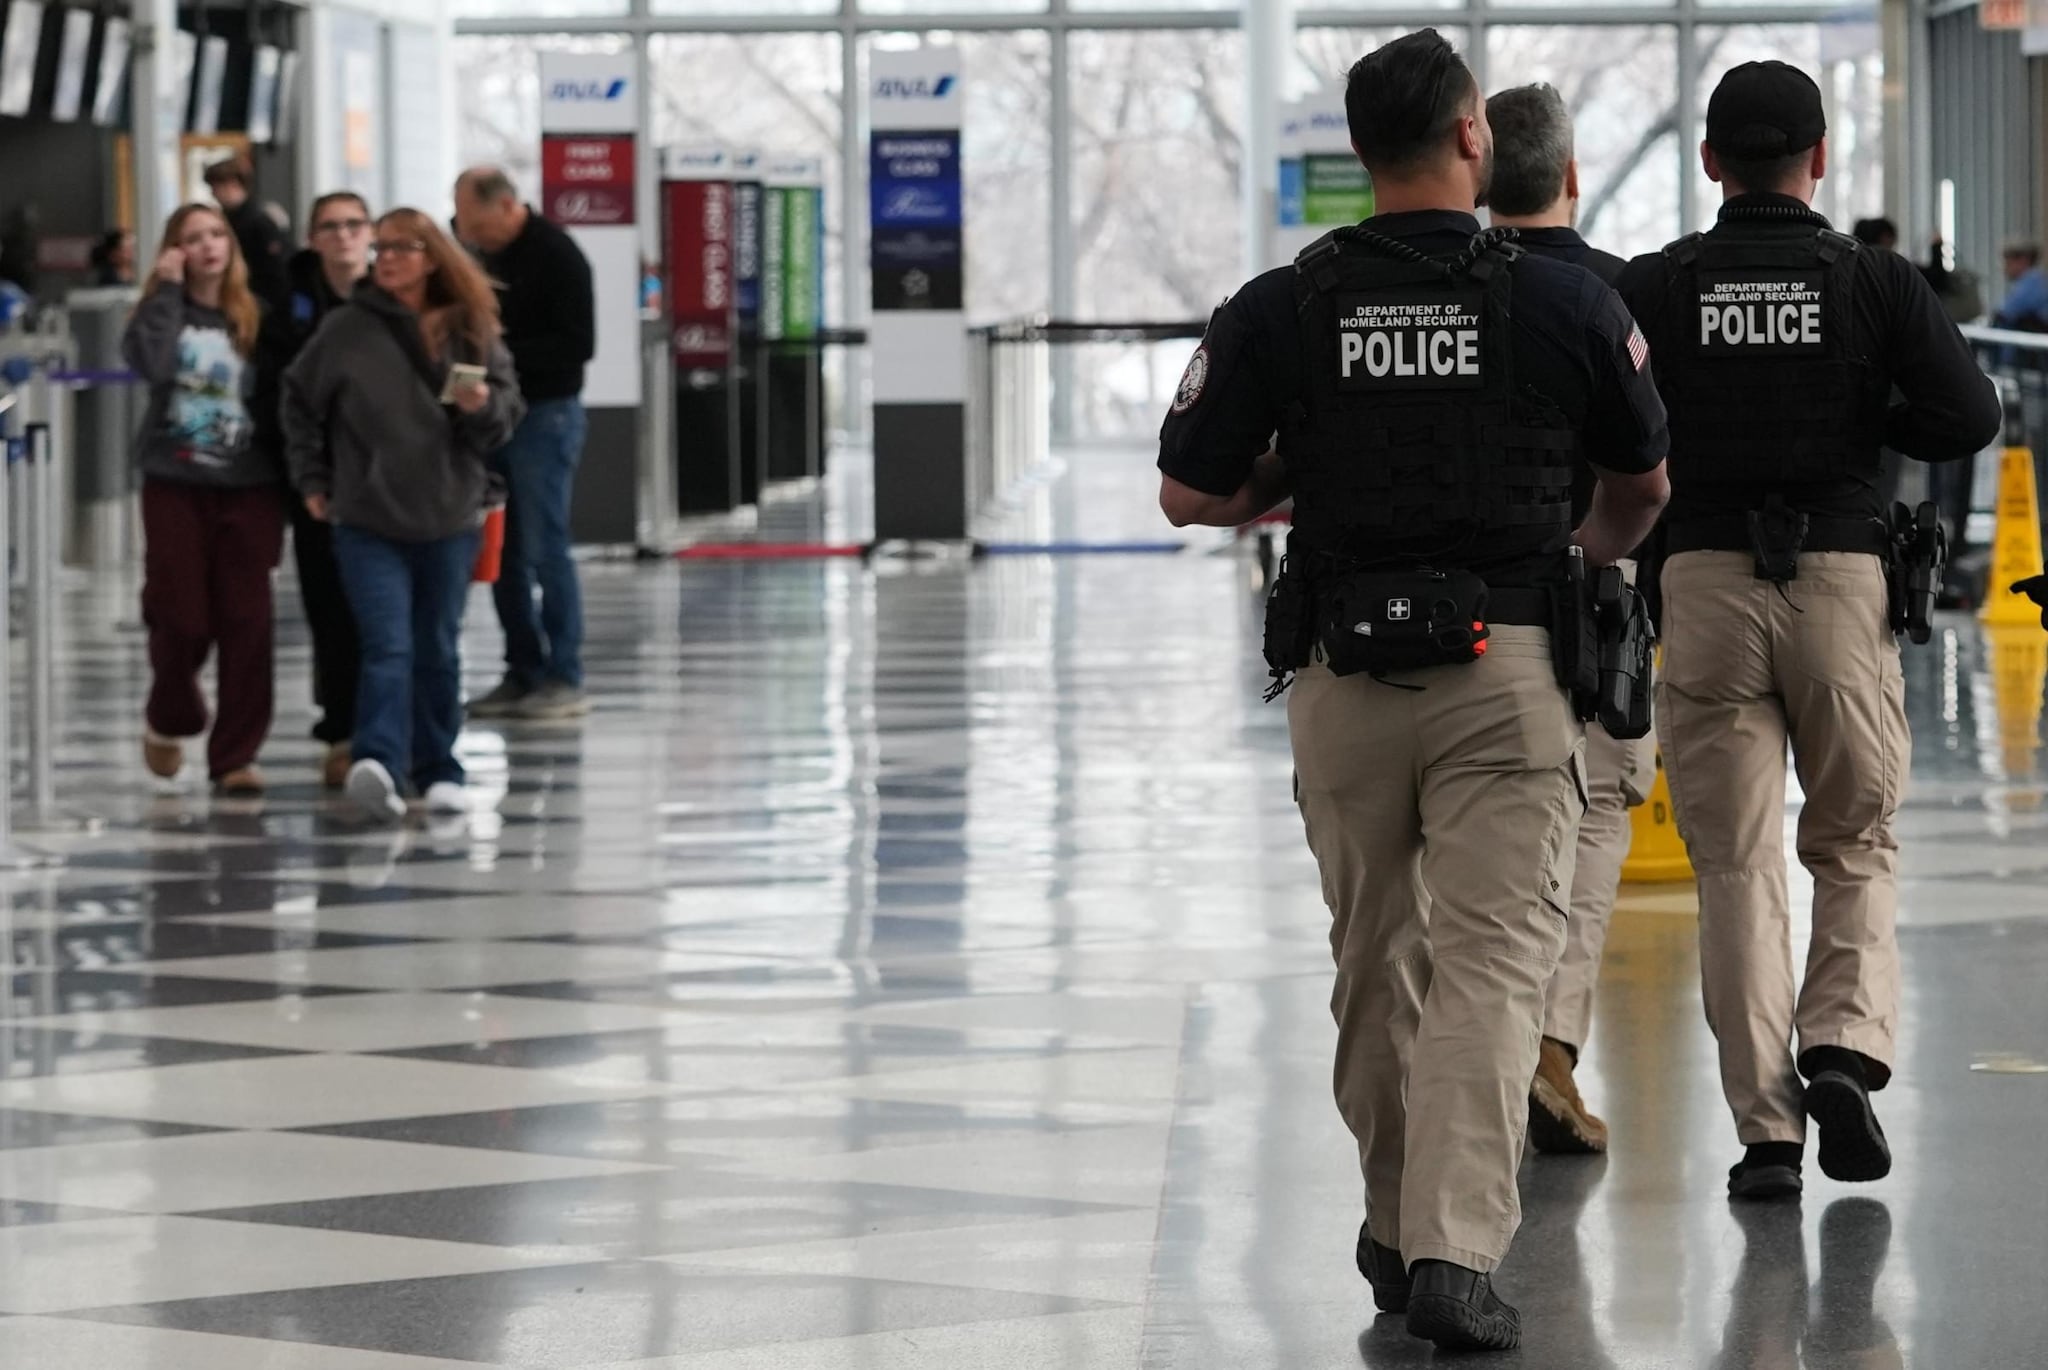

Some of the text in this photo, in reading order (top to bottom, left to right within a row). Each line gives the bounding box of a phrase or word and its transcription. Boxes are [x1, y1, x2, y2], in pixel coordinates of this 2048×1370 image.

[1714, 281, 1806, 293] DEPARTMENT OF
[1699, 291, 1821, 303] HOMELAND SECURITY
[1356, 304, 1462, 317] DEPARTMENT OF
[1339, 315, 1479, 329] HOMELAND SECURITY
[1700, 304, 1821, 346] POLICE
[1340, 330, 1480, 378] POLICE
